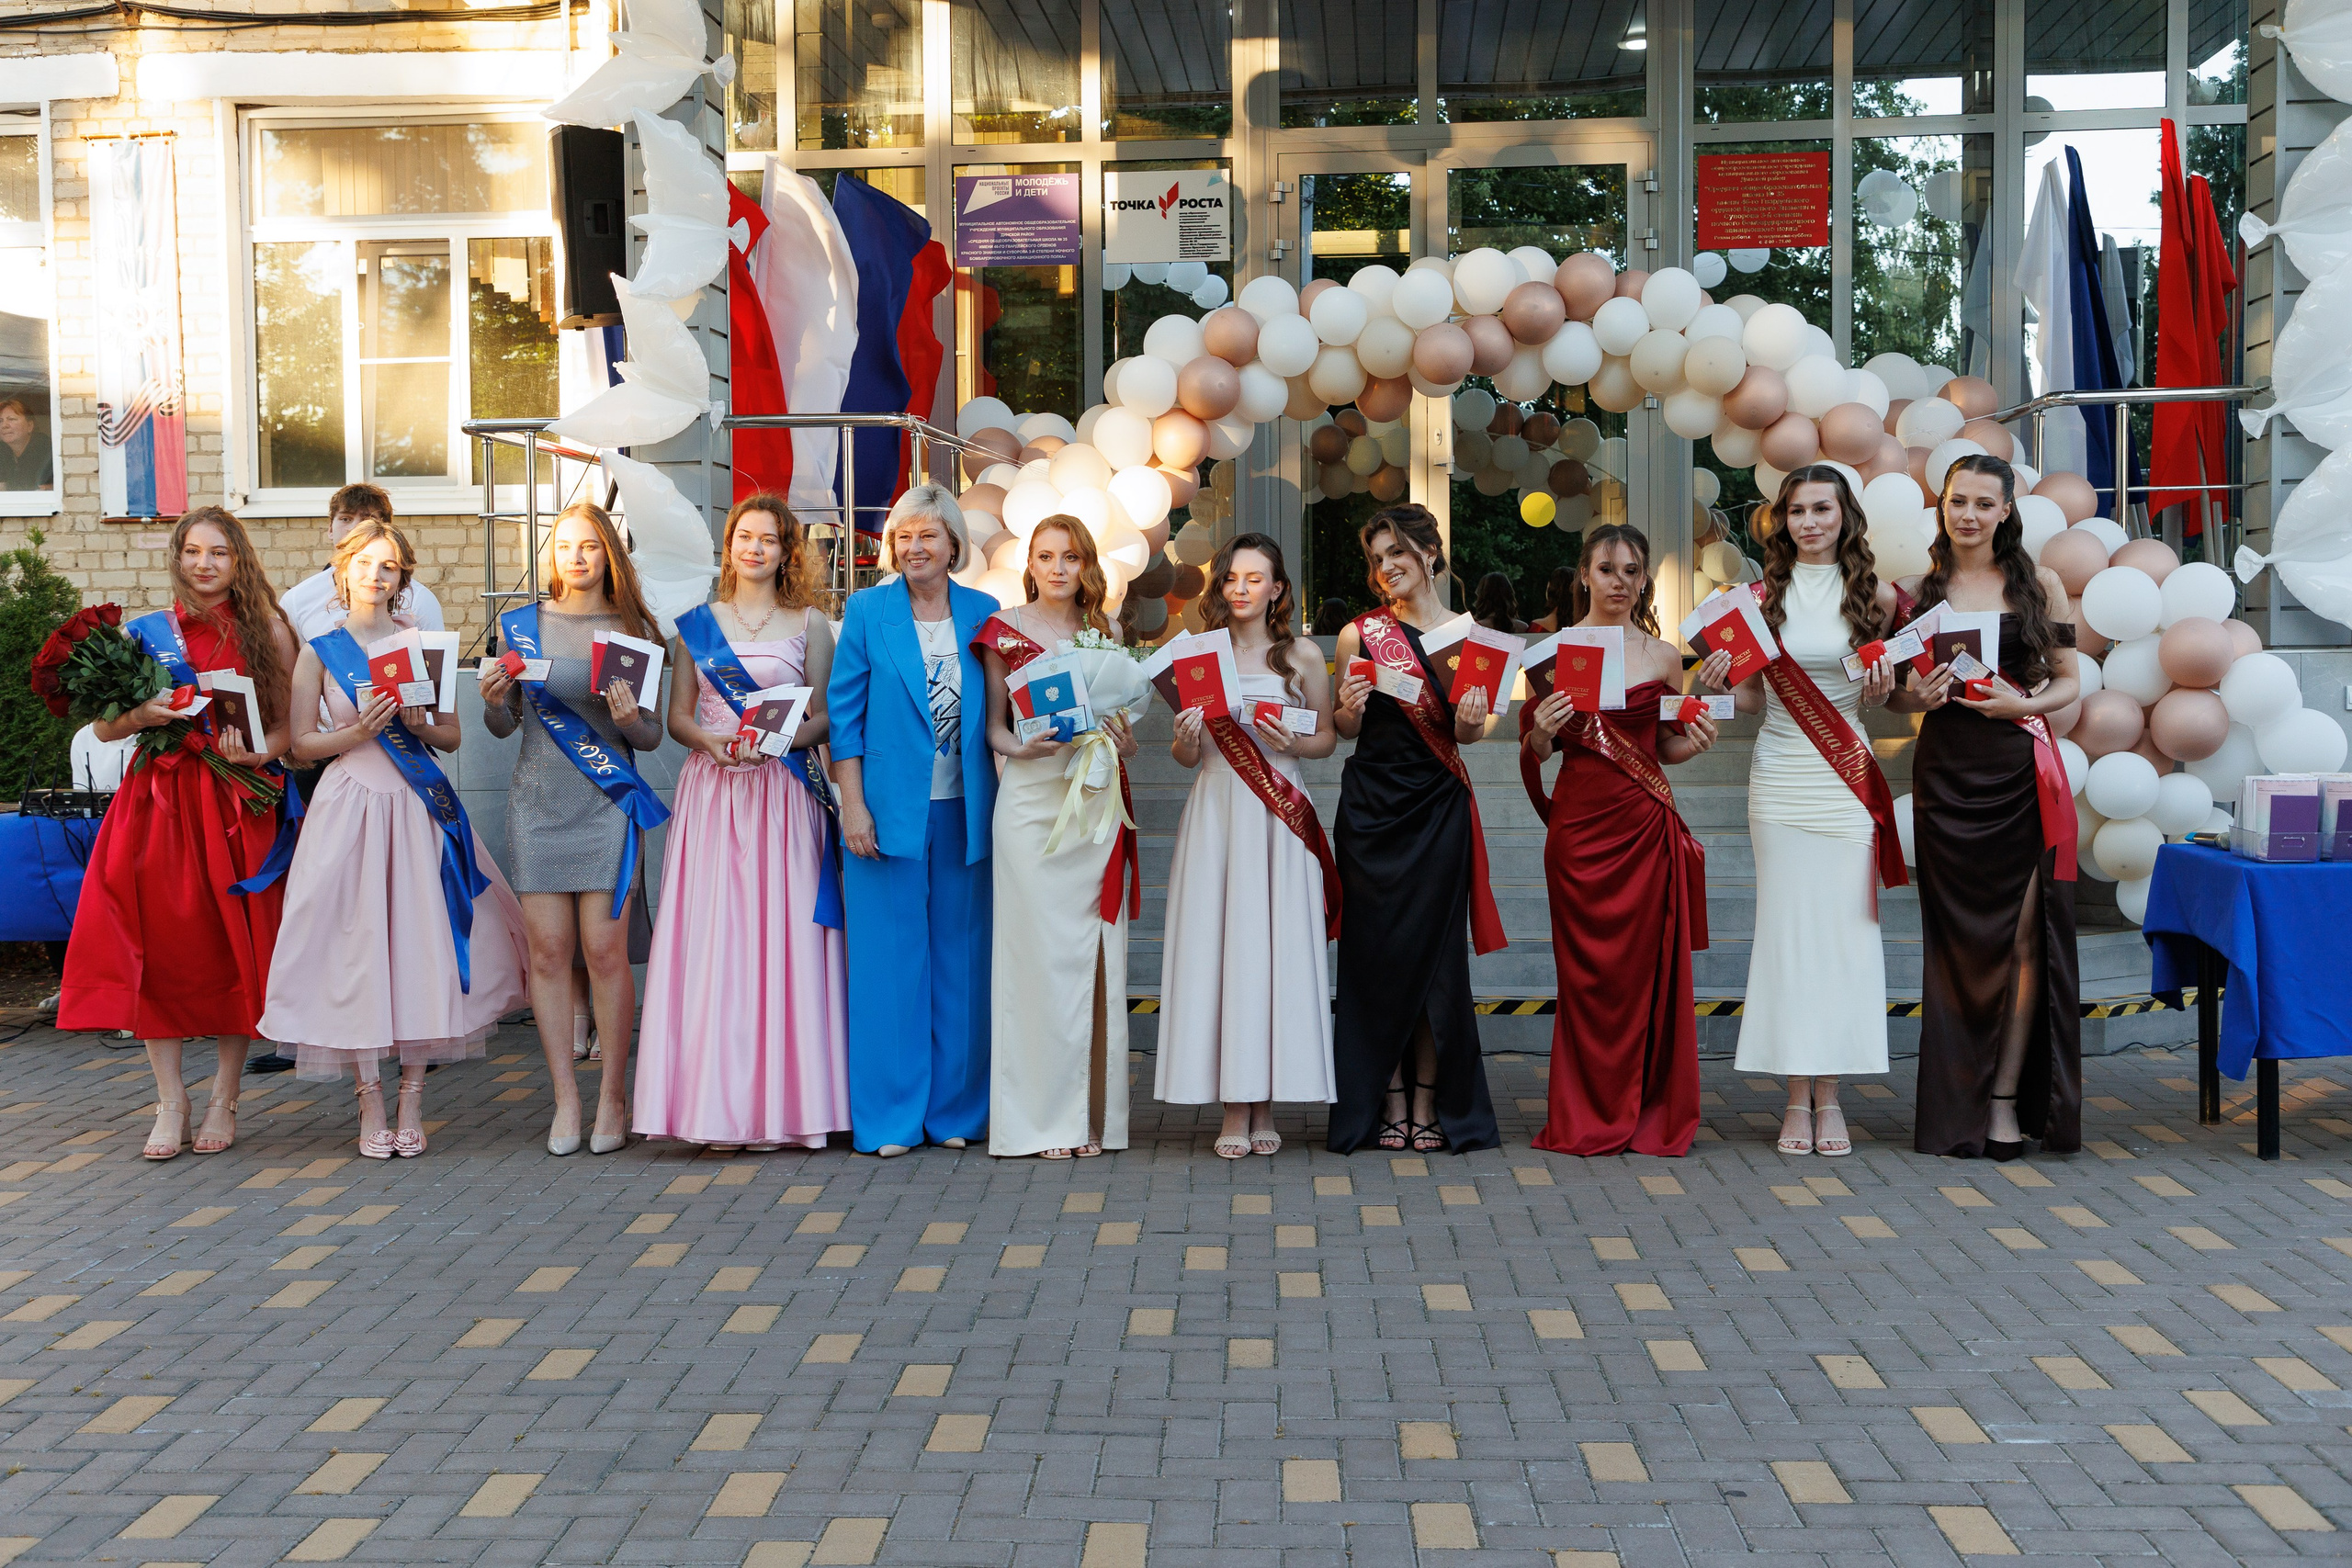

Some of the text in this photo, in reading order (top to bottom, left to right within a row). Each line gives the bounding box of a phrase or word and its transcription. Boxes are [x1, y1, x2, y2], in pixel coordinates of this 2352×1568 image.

[1015, 176, 1069, 187] МОЛОДЁЖЬ
[1023, 187, 1047, 197] ДЕТИ
[1110, 198, 1224, 210] ТОЧКА РОСТА
[1190, 694, 1215, 704] АТТЕСТАТ
[1768, 663, 1842, 751] ыпускница
[1787, 665, 1812, 693] Новикова
[1810, 691, 1838, 724] Екатерина
[568, 735, 619, 776] 2026
[1206, 716, 1295, 815] Выпускница
[1566, 713, 1669, 796] Выпускница
[1610, 726, 1632, 749] Петрова
[1632, 745, 1656, 769] Виктория
[1828, 739, 1873, 784] 2026
